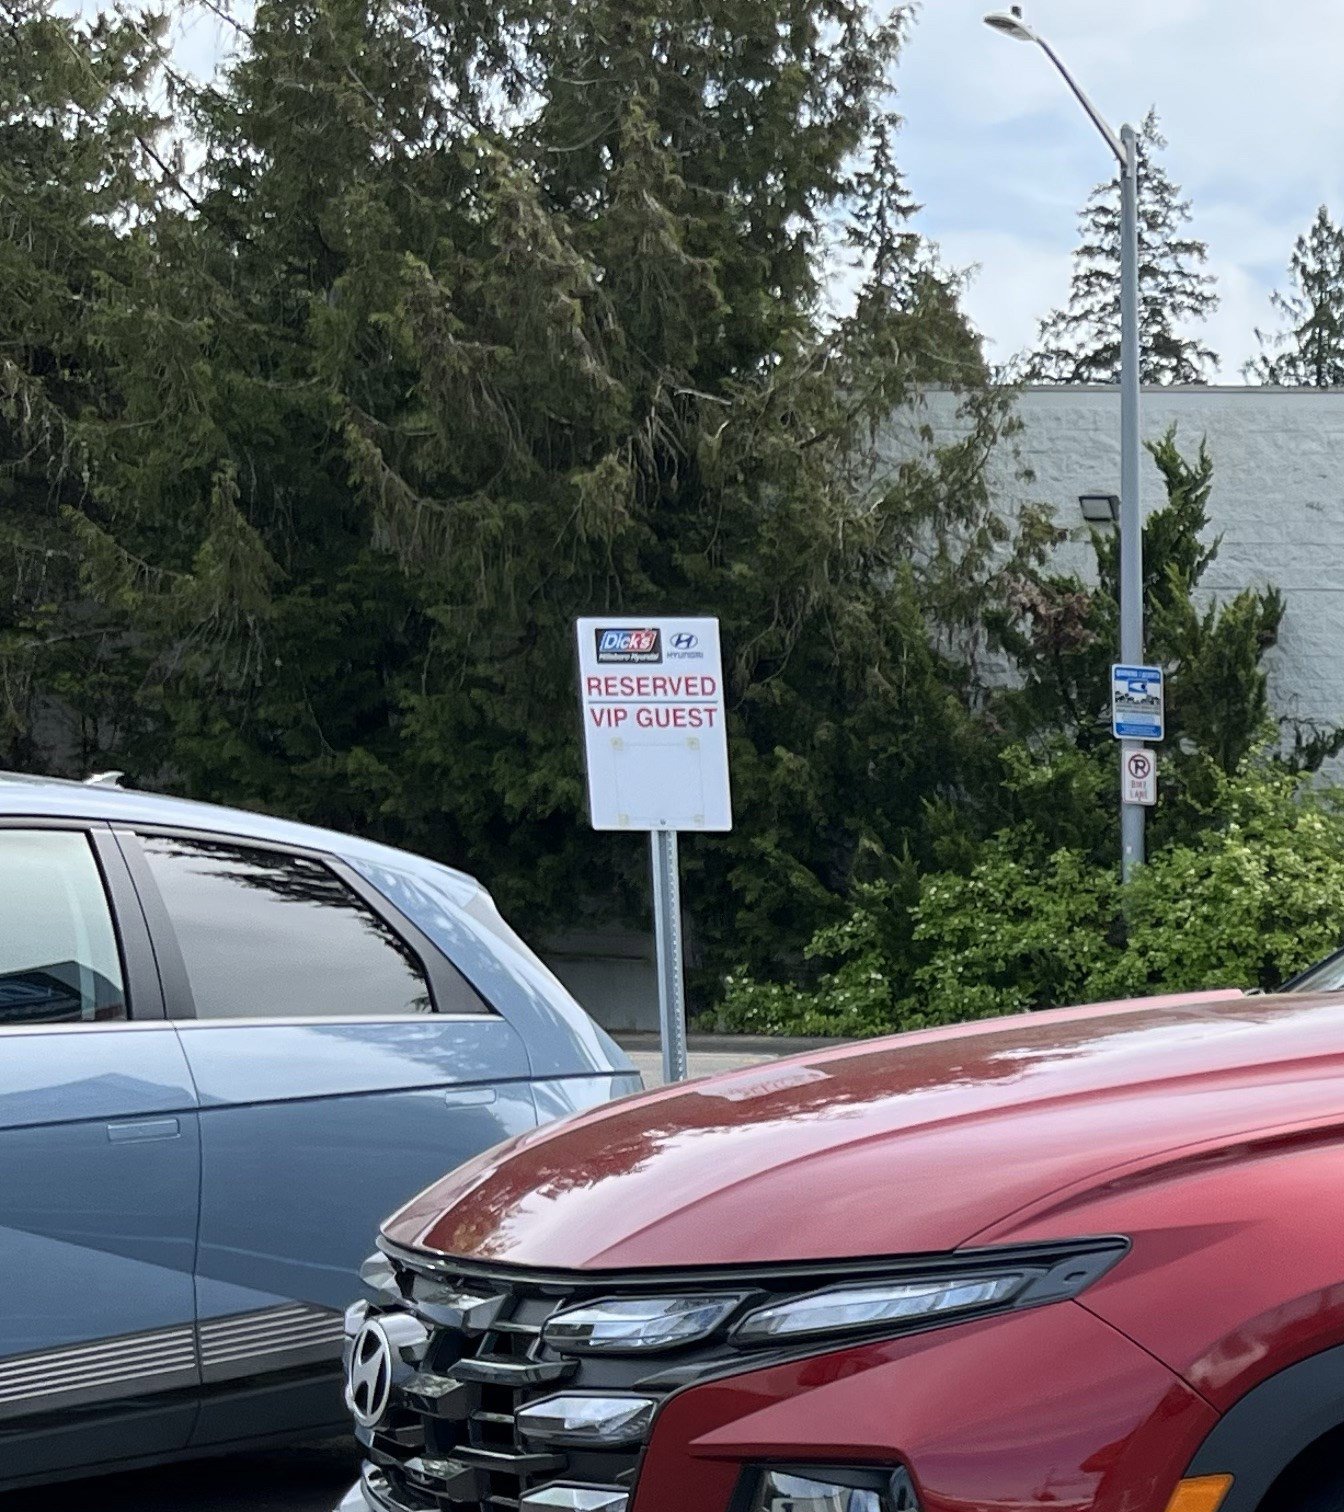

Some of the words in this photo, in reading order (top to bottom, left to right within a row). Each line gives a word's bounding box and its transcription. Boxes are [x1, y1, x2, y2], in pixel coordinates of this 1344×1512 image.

[586, 676, 717, 697] RESERVED
[590, 708, 628, 728] VIP
[636, 707, 718, 728] GUEST
